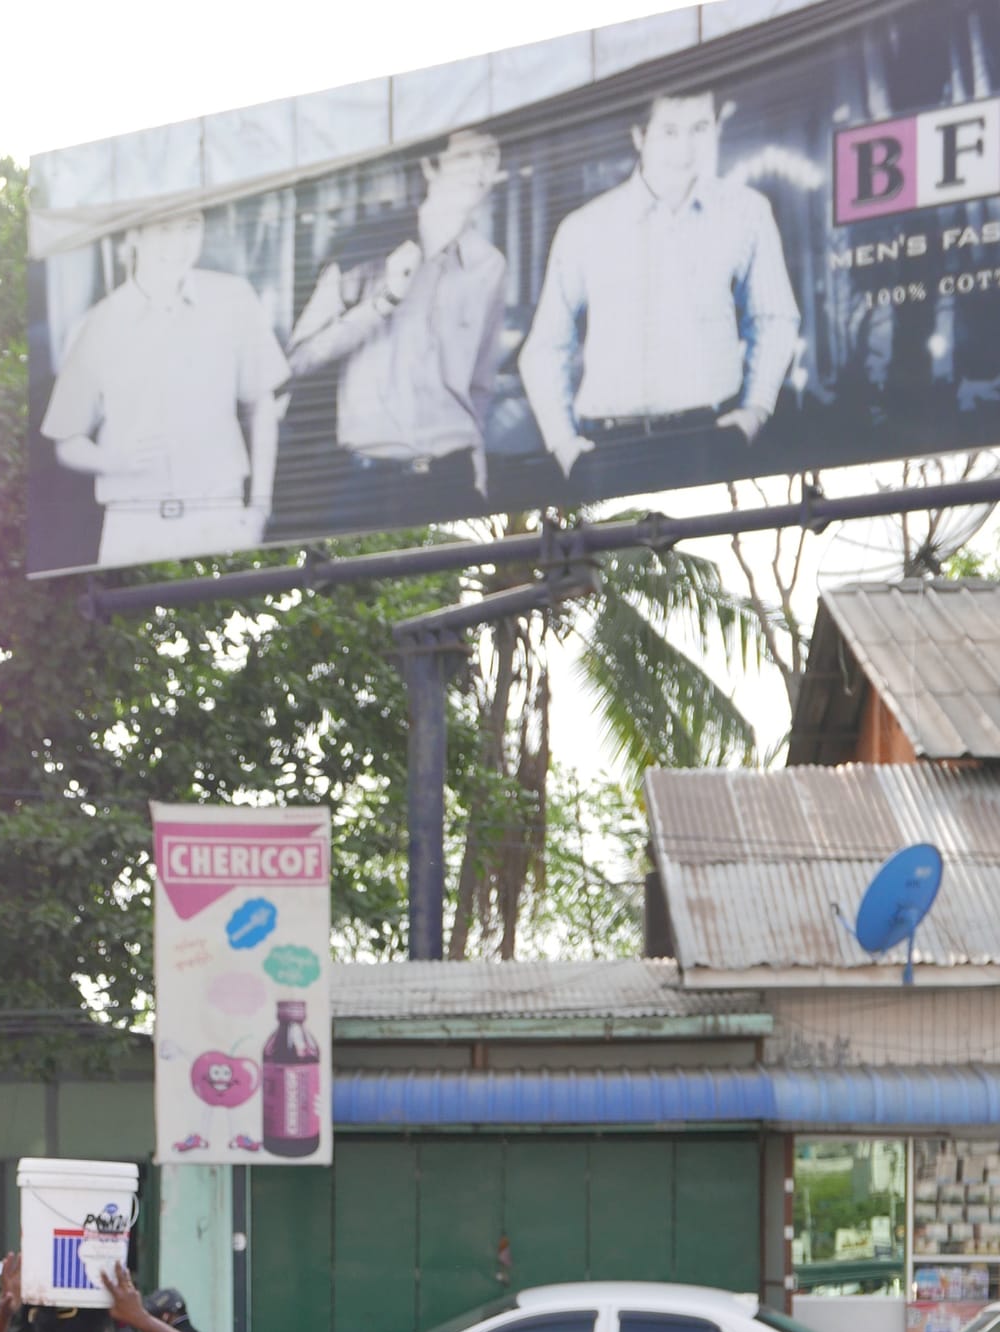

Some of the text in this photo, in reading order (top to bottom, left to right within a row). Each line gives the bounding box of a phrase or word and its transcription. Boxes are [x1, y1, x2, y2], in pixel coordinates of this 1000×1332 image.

[830, 234, 927, 270] MEN'S
[864, 282, 927, 309] 100%
[170, 844, 320, 877] CHERICOF
